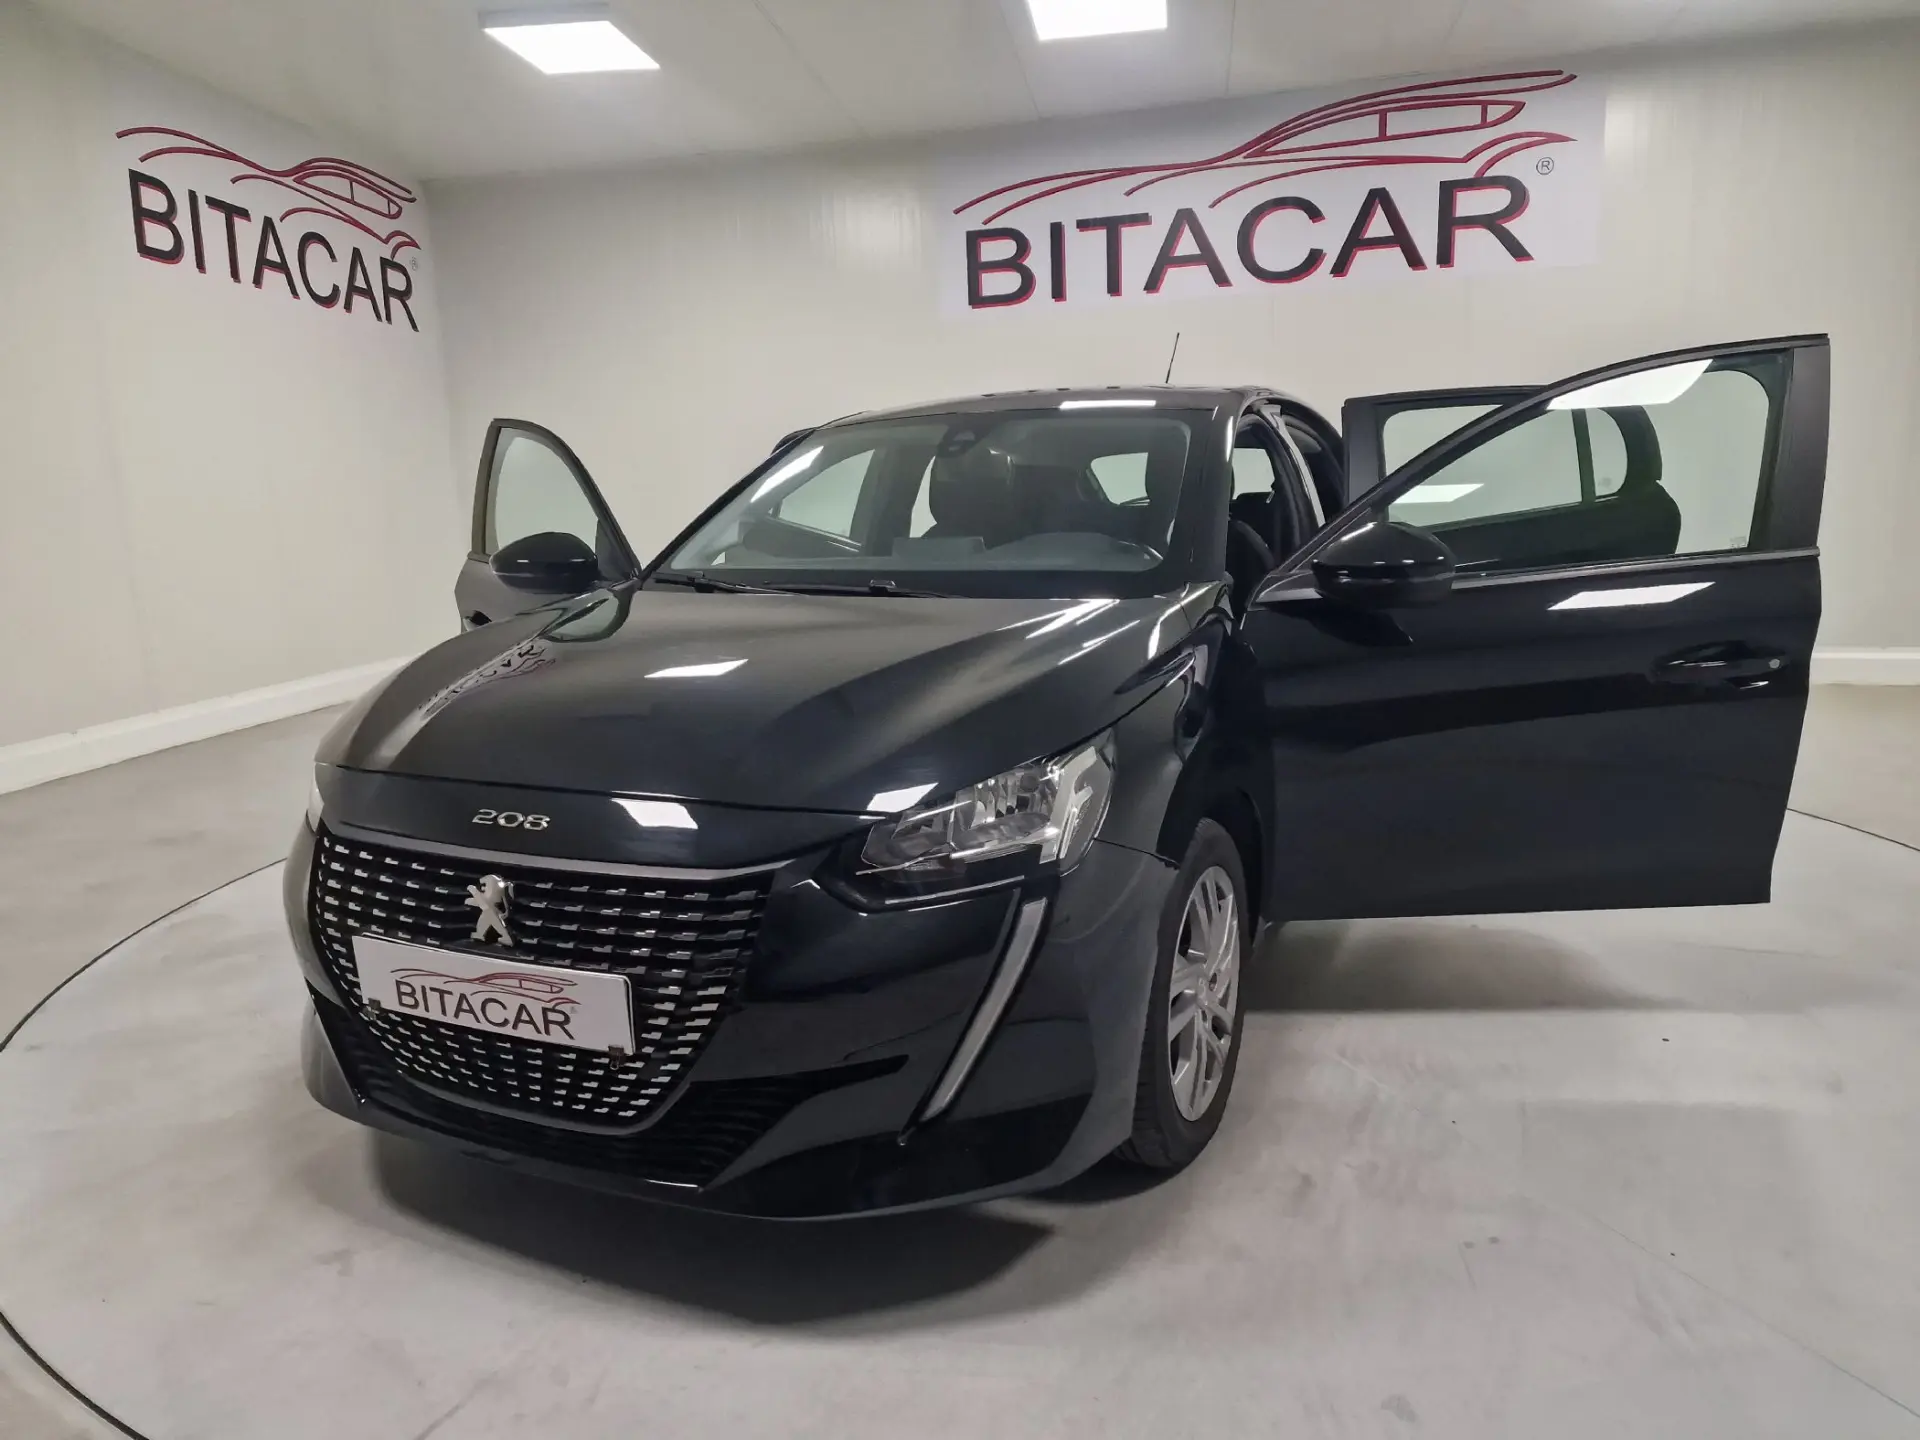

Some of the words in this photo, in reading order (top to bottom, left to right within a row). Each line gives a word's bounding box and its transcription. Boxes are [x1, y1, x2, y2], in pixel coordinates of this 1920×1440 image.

[128, 168, 419, 332] BITACAR
[965, 174, 1534, 309] BITACAR
[472, 808, 550, 831] 208
[396, 980, 575, 1039] BITACAR
